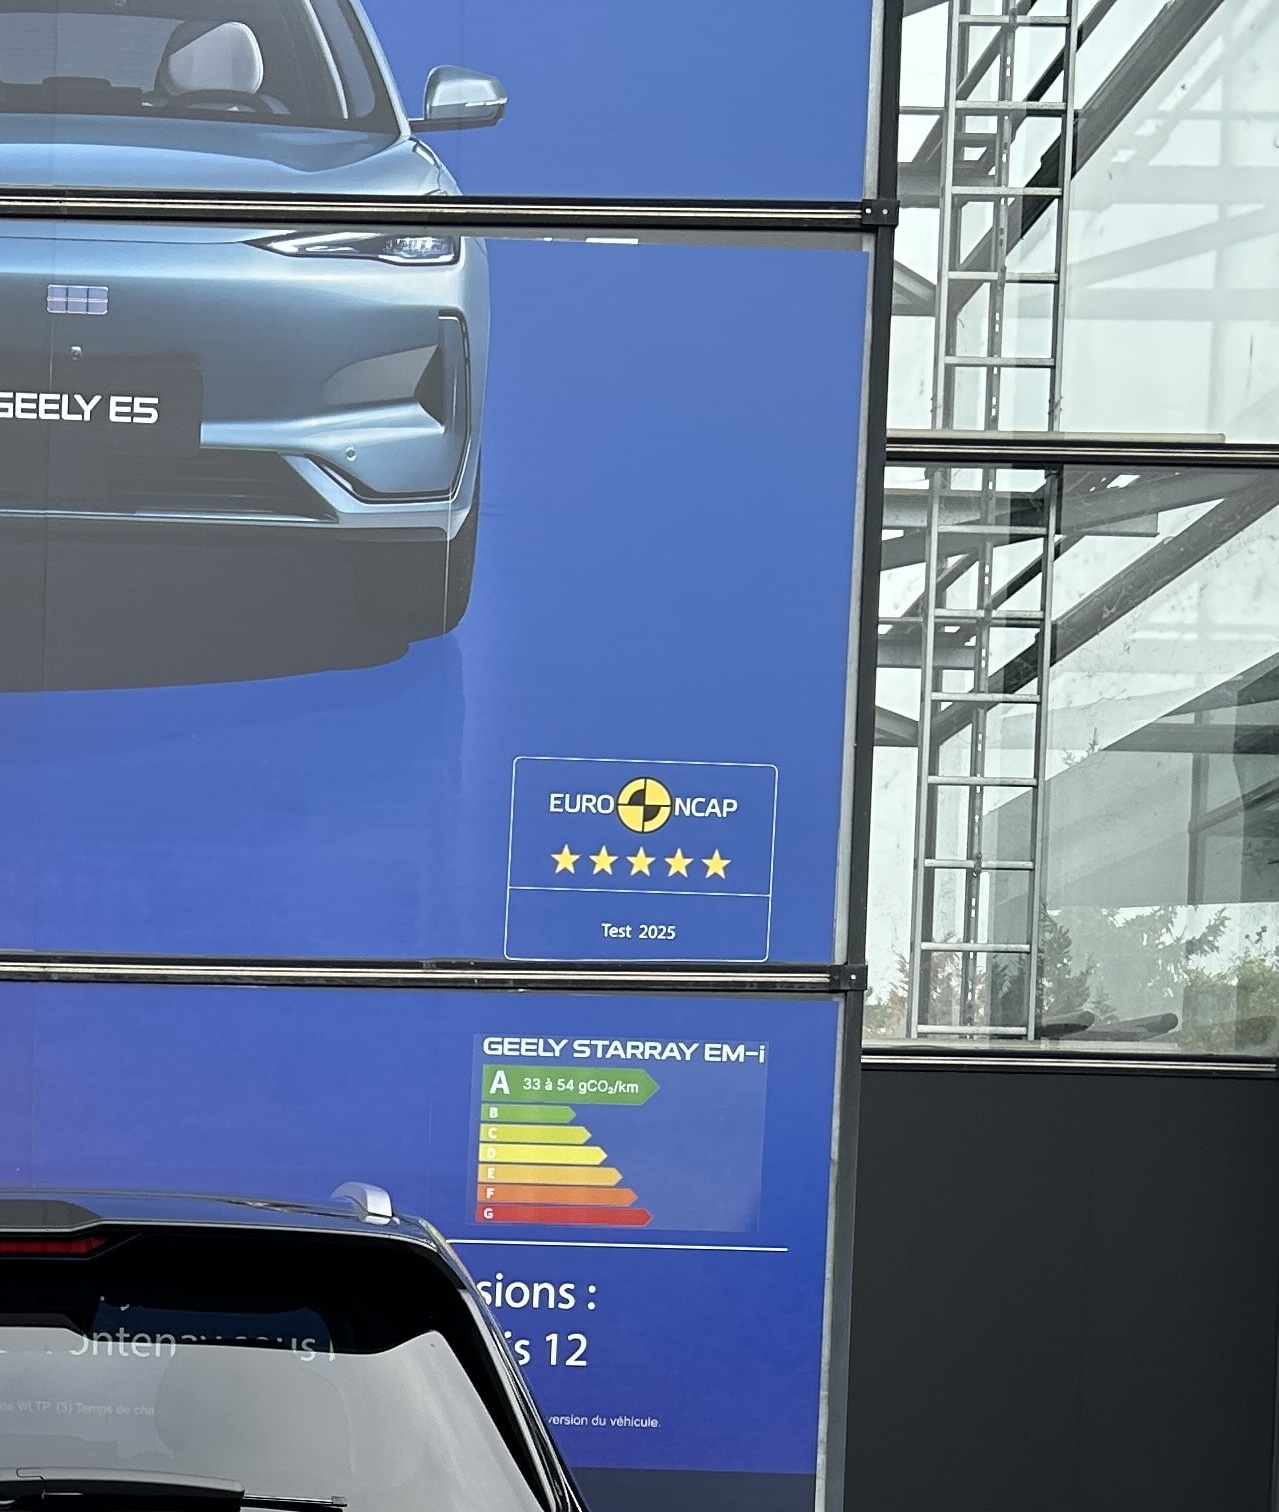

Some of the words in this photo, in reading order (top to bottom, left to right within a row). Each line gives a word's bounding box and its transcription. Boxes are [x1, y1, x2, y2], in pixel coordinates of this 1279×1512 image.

[109, 395, 159, 424] E5
[549, 793, 615, 814] EURO
[674, 798, 738, 818] NCAP
[601, 923, 632, 939] Test
[639, 924, 676, 940] 2025
[483, 1037, 568, 1057] GEELY
[573, 1040, 699, 1061] STARRAY
[704, 1043, 765, 1063] EM-i
[489, 1070, 510, 1094] A
[523, 1078, 541, 1091] 33
[544, 1078, 552, 1091] à
[556, 1079, 574, 1092] 54
[489, 1107, 498, 1118] B
[488, 1127, 497, 1139] C
[487, 1167, 495, 1179] E
[486, 1188, 495, 1199] F
[483, 1208, 493, 1219] G
[545, 1333, 588, 1366] 12
[592, 1415, 606, 1426] du
